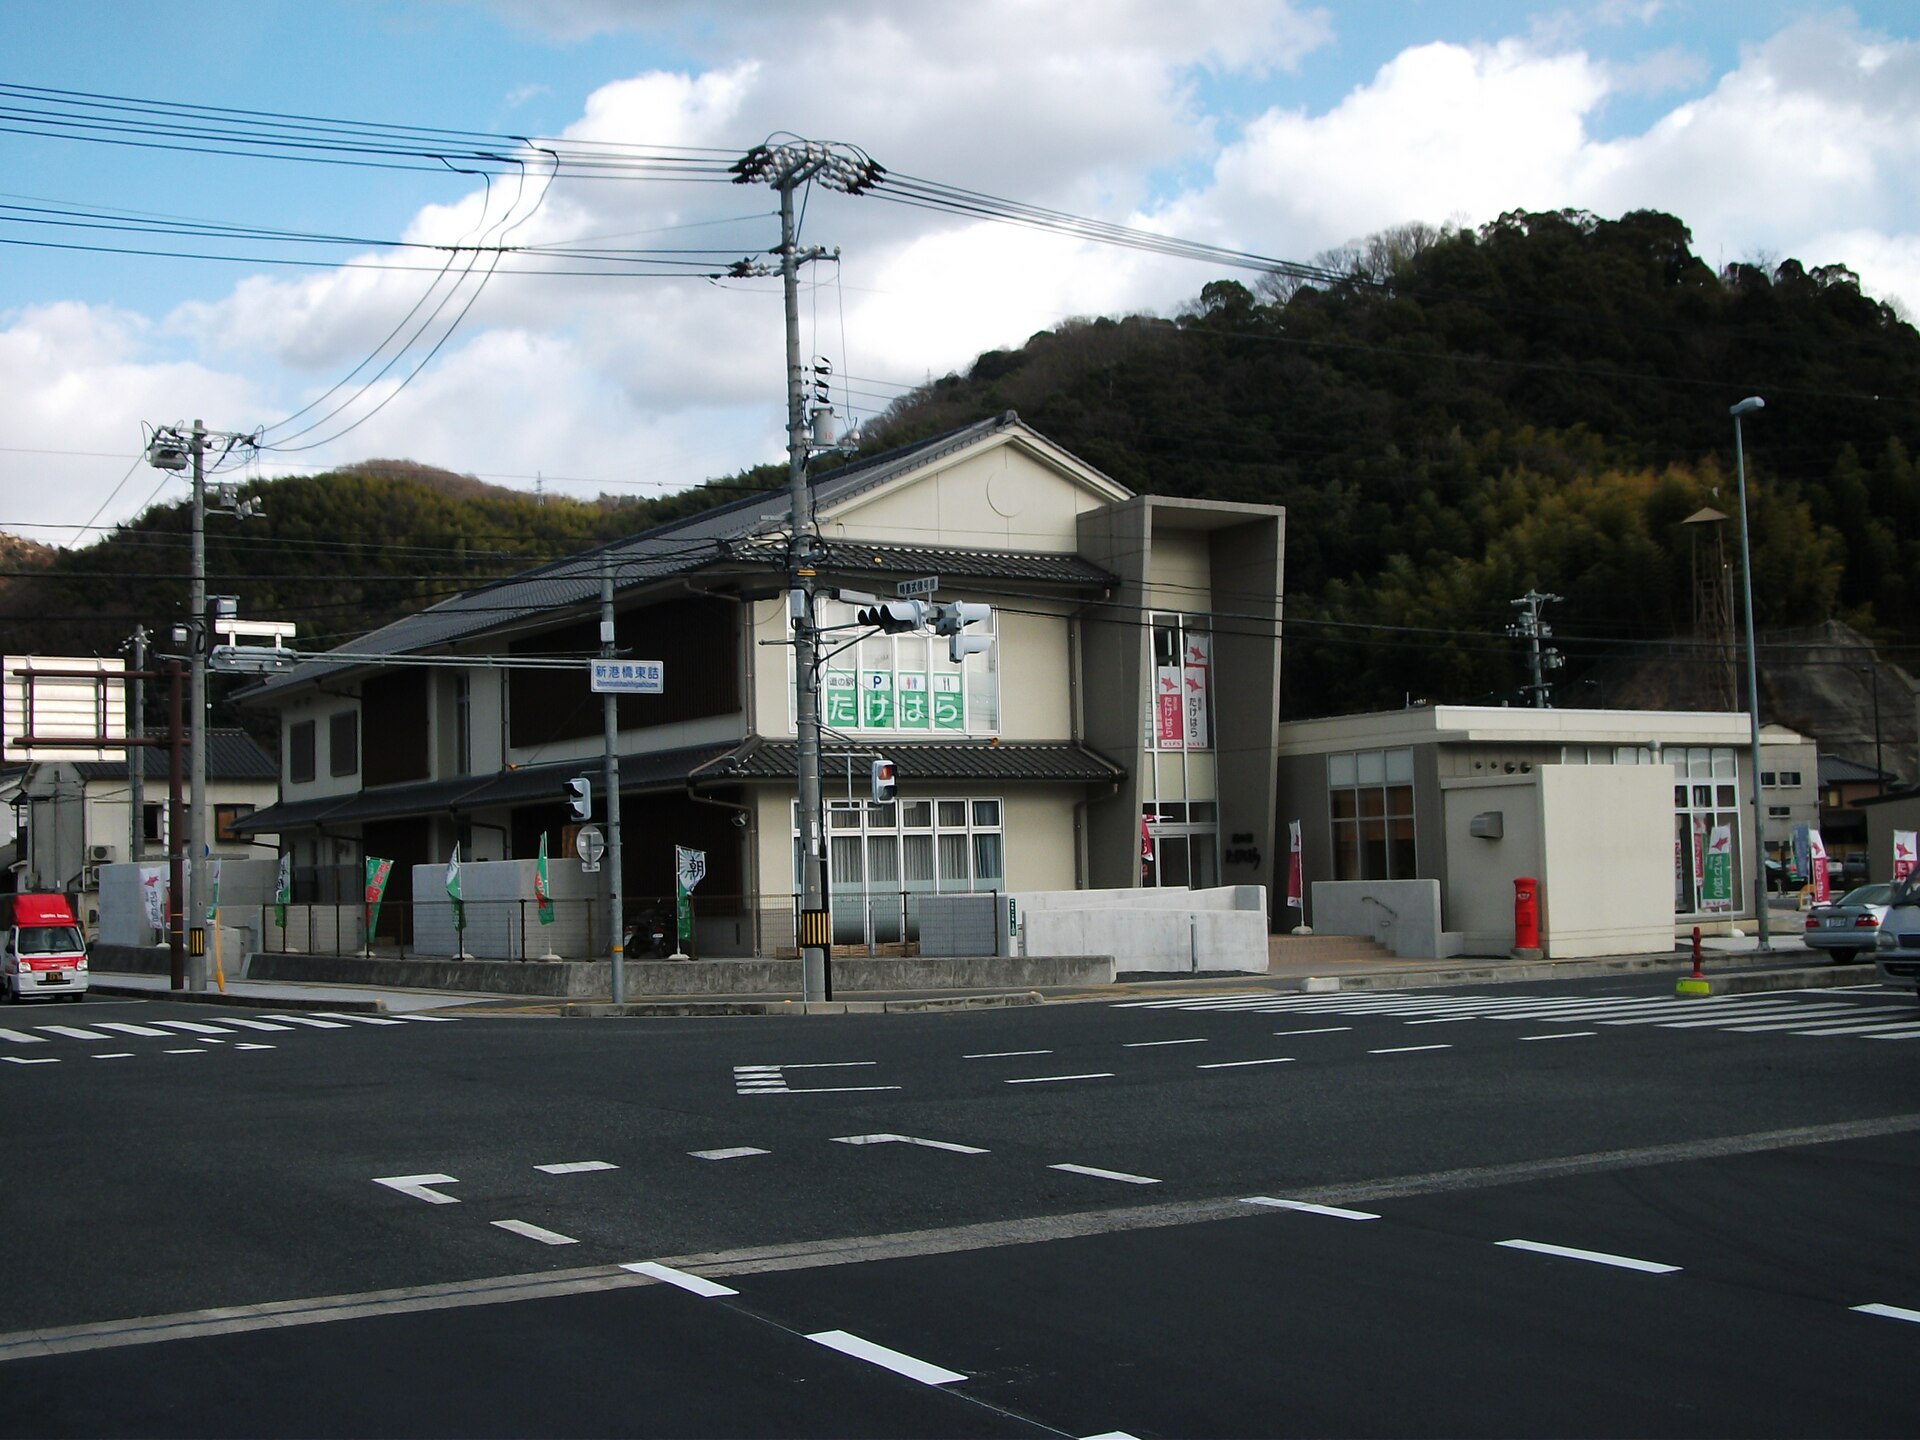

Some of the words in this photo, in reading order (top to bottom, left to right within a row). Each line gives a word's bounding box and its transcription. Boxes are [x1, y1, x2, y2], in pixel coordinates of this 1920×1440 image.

[595, 665, 659, 680] 新港橋東詰
[829, 677, 855, 688] 道の駅
[830, 693, 959, 723] たけはら
[1164, 696, 1174, 738] たけはら
[1189, 697, 1198, 738] たけはら
